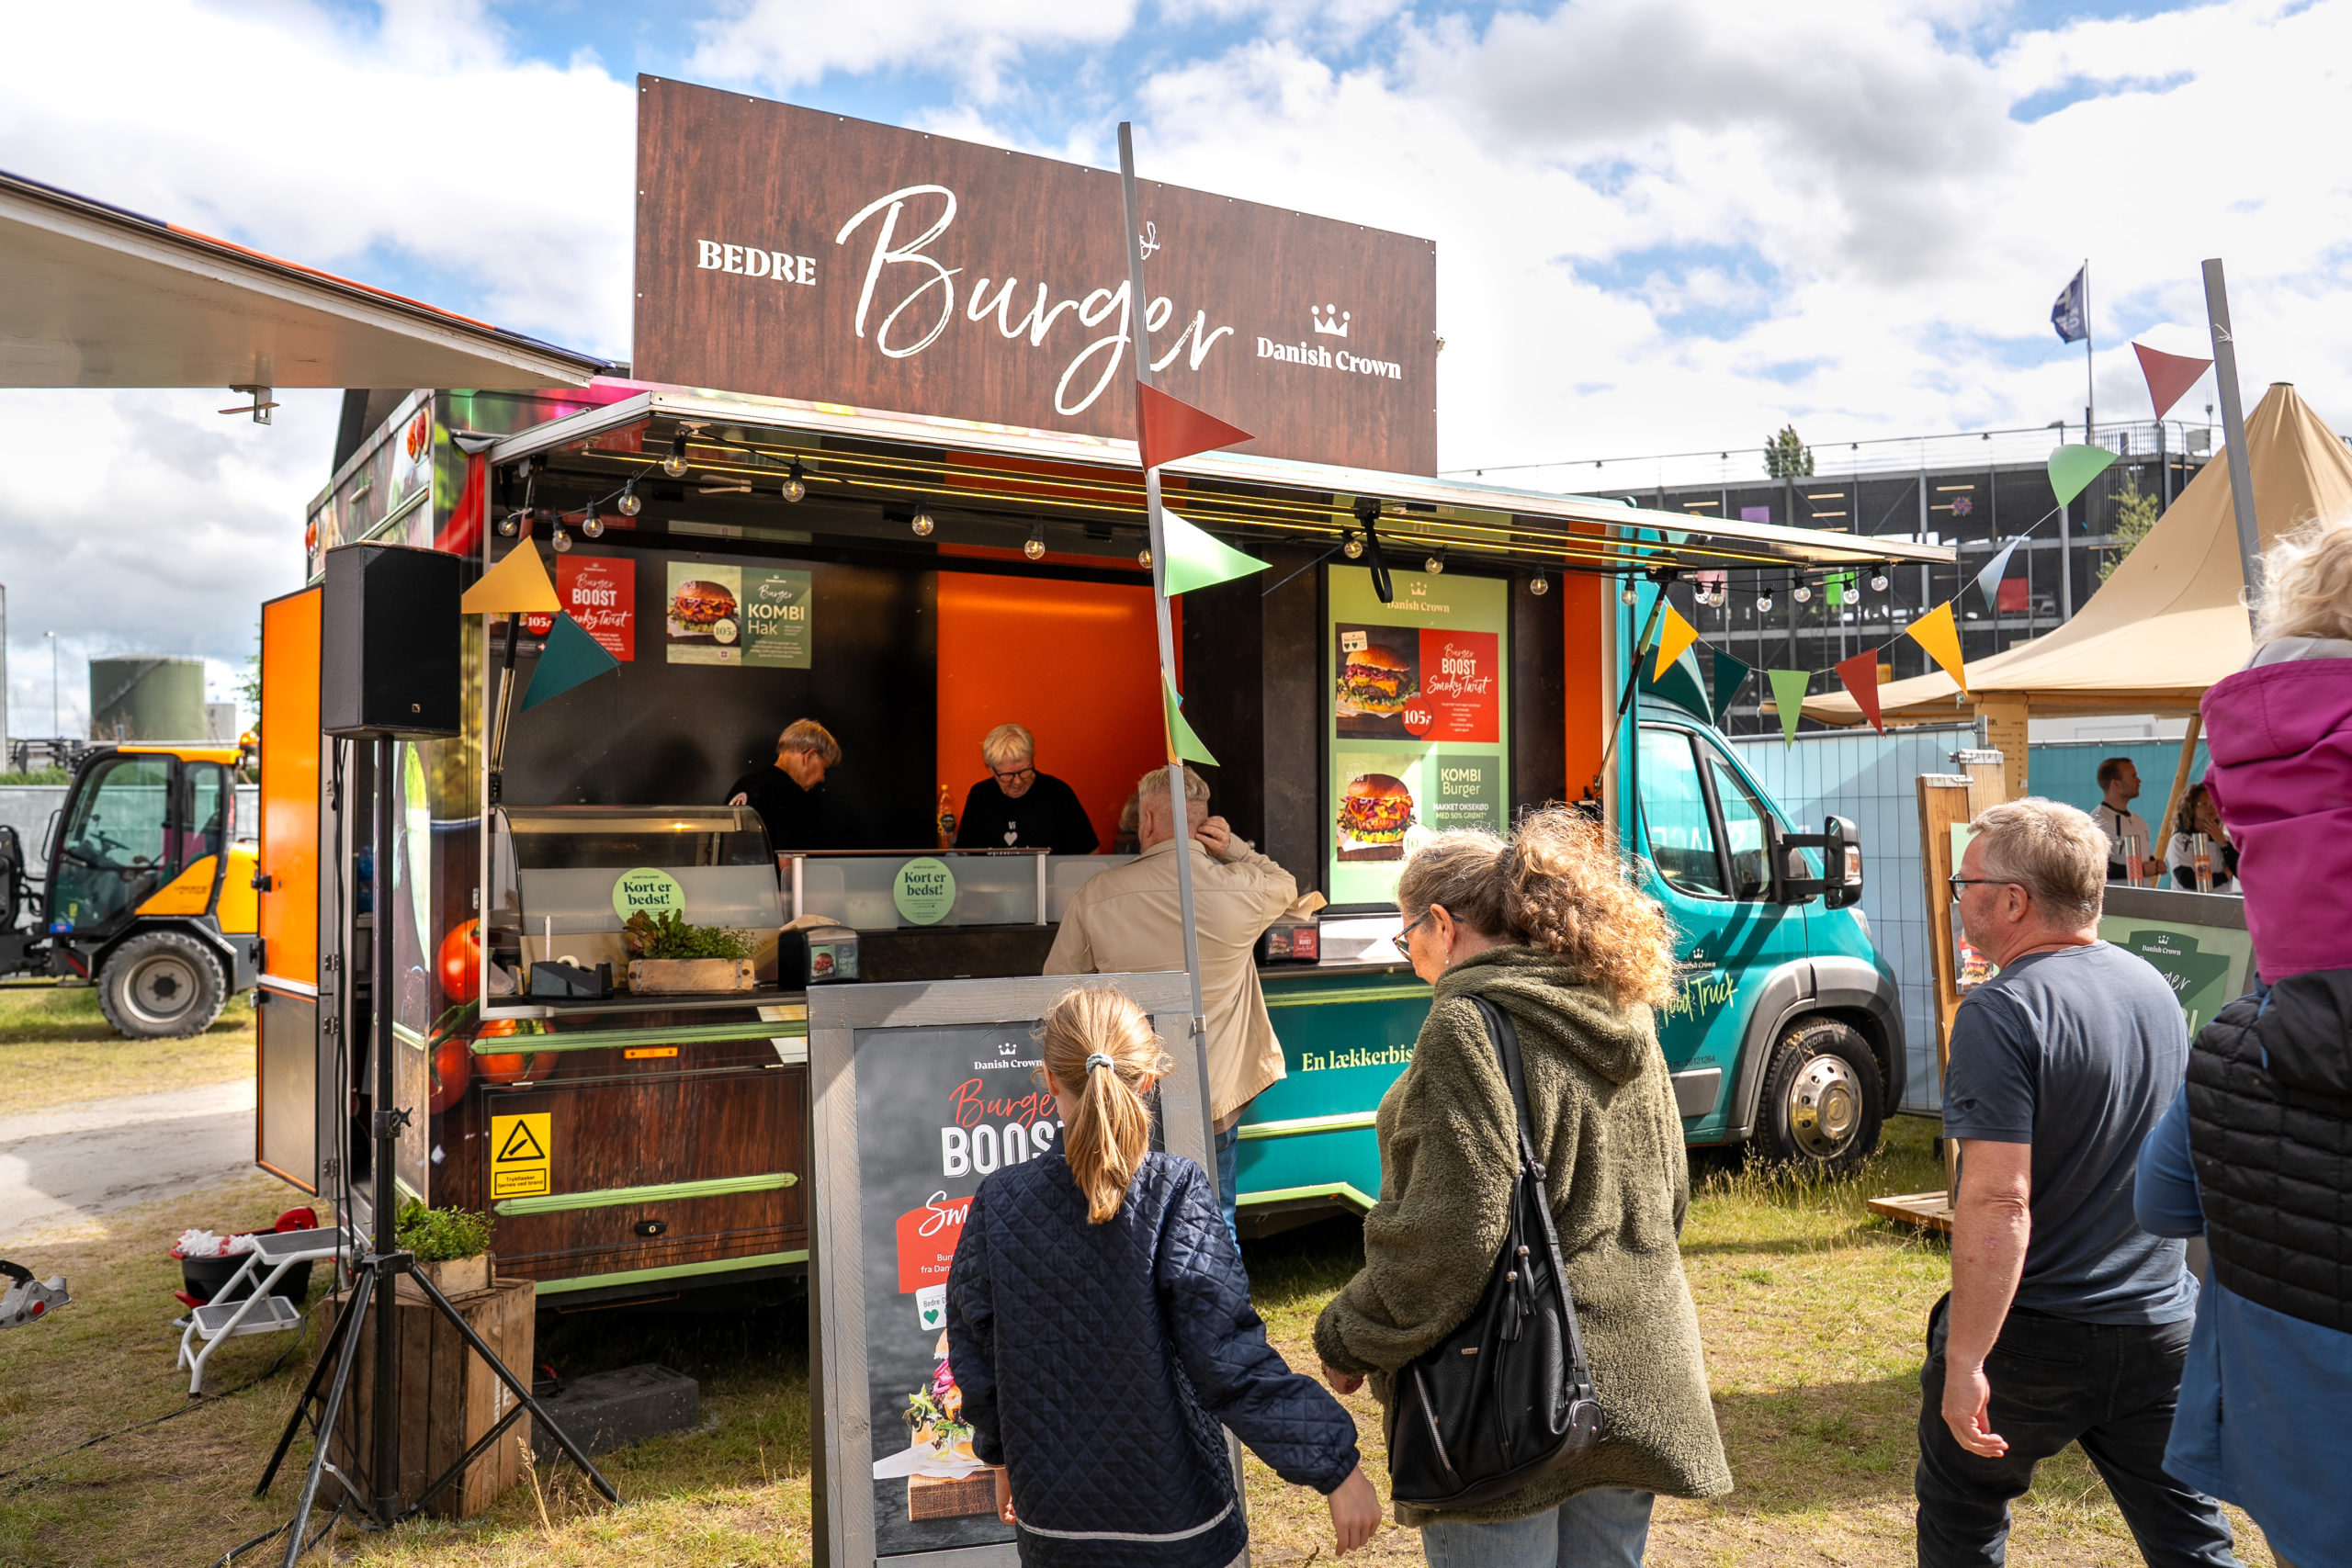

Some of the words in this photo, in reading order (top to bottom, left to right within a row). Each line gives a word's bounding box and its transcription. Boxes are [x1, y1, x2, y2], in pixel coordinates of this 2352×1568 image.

[697, 239, 817, 287] BEDRE
[836, 184, 1235, 416] Burger
[1256, 336, 1333, 369] Danish
[1335, 350, 1403, 380] Crown
[572, 588, 617, 606] BOOST
[747, 604, 806, 621] KOMBI
[1386, 600, 1420, 612] Danish
[1420, 602, 1451, 614] Crown
[596, 609, 632, 628] Twist
[747, 619, 779, 636] Hak
[1443, 642, 1475, 660] Burger
[1442, 658, 1477, 676] BOOST
[1427, 672, 1463, 698] Smoky
[1460, 674, 1493, 695] Twist
[1404, 709, 1432, 726] 105,-
[1441, 768, 1482, 782] KOMBI
[1442, 781, 1482, 798] Burger
[904, 872, 932, 883] Kort
[933, 874, 946, 883] er
[624, 882, 655, 893] Kort
[658, 883, 672, 893] er
[907, 885, 944, 896] bedst!
[628, 894, 671, 905] bedst!
[2142, 944, 2162, 954] Danish
[2162, 947, 2181, 956] Crown
[1690, 972, 1739, 1017] Truck
[974, 1059, 1010, 1070] Danish
[1011, 1058, 1044, 1068] Crown
[1301, 1053, 1326, 1072] En
[1329, 1043, 1418, 1070] lækkerbis
[948, 1077, 1058, 1134] Burge
[941, 1120, 1066, 1179] BOOS
[921, 1264, 933, 1274] fra
[933, 1264, 952, 1273] Dan
[923, 1298, 941, 1308] Bedre
